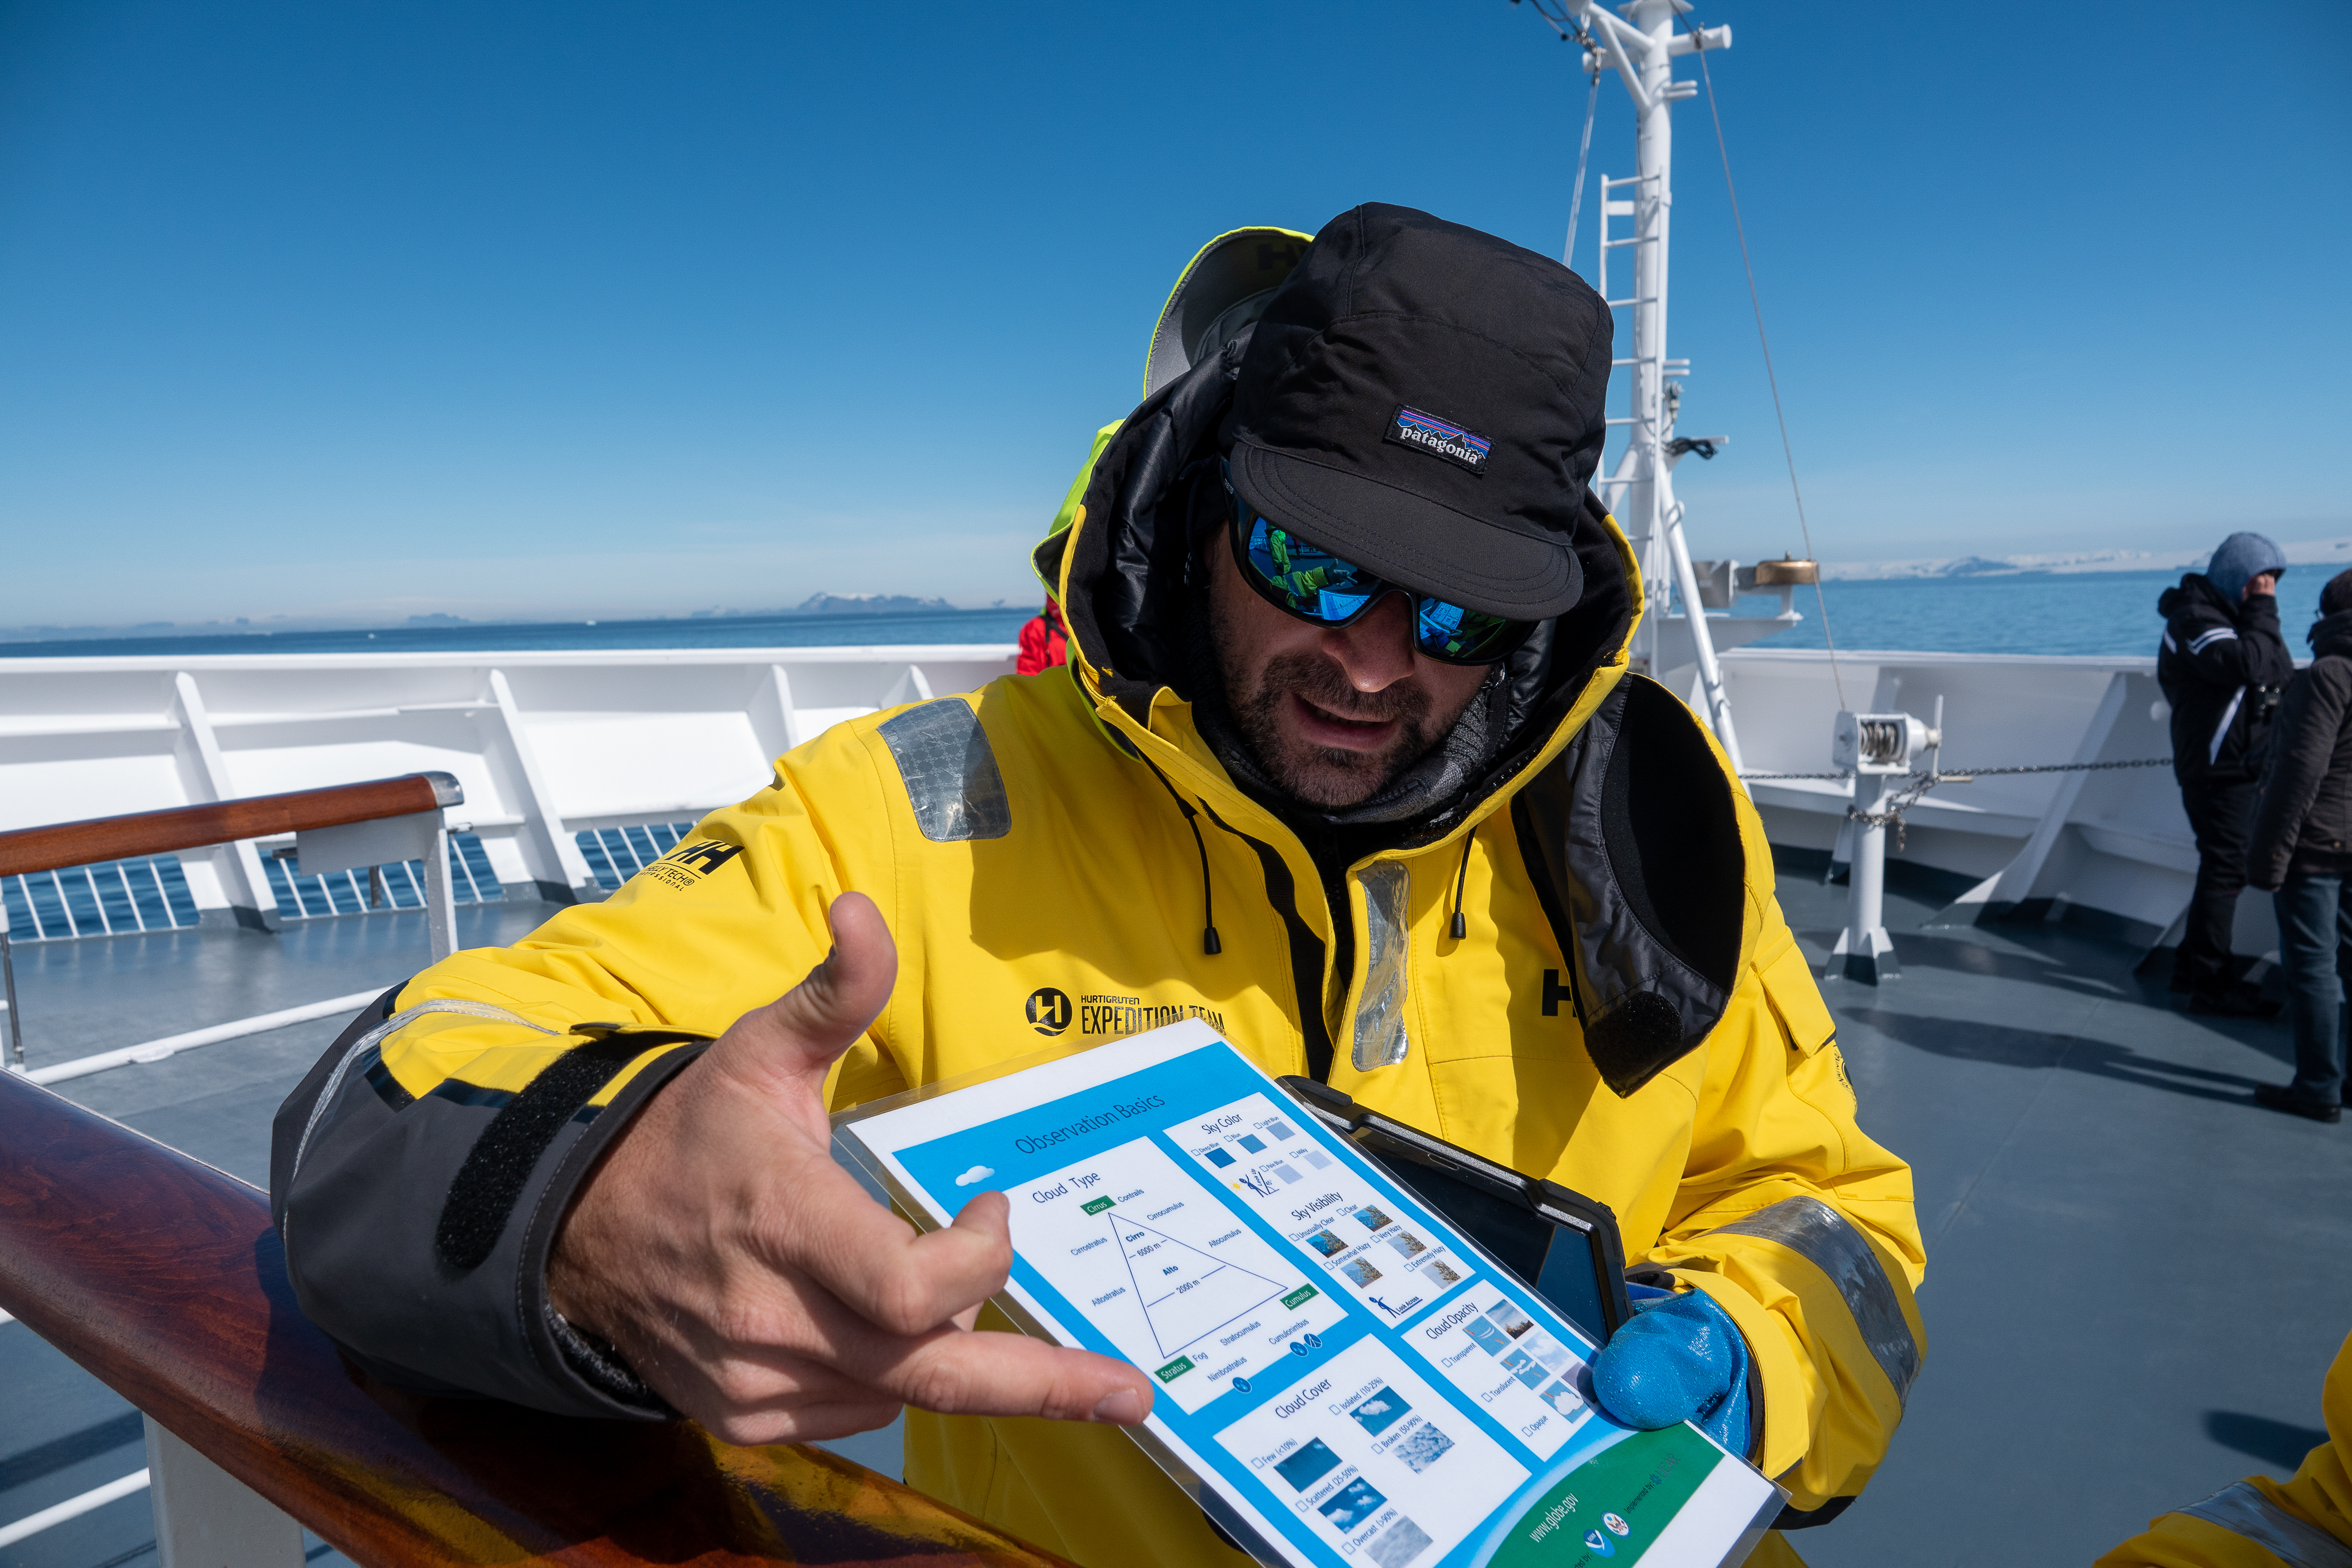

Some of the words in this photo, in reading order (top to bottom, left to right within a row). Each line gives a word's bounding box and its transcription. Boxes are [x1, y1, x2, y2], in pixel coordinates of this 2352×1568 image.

[1081, 995, 1139, 1005] HURTIGRUTEN
[1081, 1005, 1184, 1035] EXPEDITION
[1015, 1115, 1120, 1154] Observation
[1113, 1095, 1165, 1118] Basics
[1202, 1123, 1222, 1134] Sky
[1218, 1113, 1243, 1127] Color
[1260, 1119, 1270, 1127] Light
[1199, 1145, 1210, 1153] Deep
[1032, 1183, 1069, 1203] Cloud
[1069, 1173, 1100, 1188] Type
[1118, 1188, 1144, 1203] Contrails
[1087, 1201, 1107, 1213] Cirrus
[1147, 1201, 1184, 1221] Cirrocumulus
[1292, 1207, 1311, 1221] Sky
[1308, 1191, 1343, 1213] Visibility
[1344, 1204, 1358, 1213] Clear
[1125, 1231, 1145, 1242] Cirro
[1209, 1228, 1241, 1247] Altocumulus
[1297, 1222, 1323, 1239] Unusually
[1320, 1216, 1335, 1228] Clear
[1379, 1230, 1390, 1239] Very
[1389, 1224, 1403, 1234] Hazy
[1071, 1236, 1107, 1256] Cirrostratus
[1137, 1245, 1154, 1256] 6000
[1332, 1249, 1357, 1266] Somewhat
[1356, 1242, 1371, 1253] Hazy
[1412, 1252, 1435, 1268] Extremely
[1432, 1245, 1446, 1256] Hazy
[1162, 1265, 1179, 1275] Alto
[1092, 1286, 1126, 1306] Altostratus
[1176, 1283, 1193, 1294] 2000
[1285, 1289, 1311, 1307] Cumulus
[1405, 1295, 1419, 1306] Across
[1426, 1318, 1452, 1339] Cloud
[1447, 1302, 1479, 1324] Opacity
[1220, 1320, 1261, 1346] Stratocumulus
[1268, 1318, 1309, 1345] Cumulonimbus
[1192, 1351, 1209, 1362] Fog
[1449, 1342, 1477, 1363] Transparent
[1161, 1362, 1187, 1379] Stratus
[1207, 1357, 1247, 1382] Nimbostratus
[1340, 1392, 1362, 1410] Isolated
[1360, 1377, 1384, 1396] (10-25%)
[1490, 1375, 1516, 1398] Translucent
[1275, 1396, 1306, 1418] Cloud
[1302, 1378, 1332, 1400] Cover
[1381, 1431, 1401, 1448] Broken
[1399, 1415, 1423, 1434] (50-90%)
[1530, 1415, 1548, 1431] Opaque
[1262, 1452, 1277, 1464] Few
[1276, 1438, 1298, 1456] (<10%)
[1655, 1453, 1680, 1479] UCAR
[1306, 1482, 1335, 1506] Scattered
[1332, 1464, 1359, 1486] (25-50%)
[1623, 1487, 1648, 1514] Implemented
[1645, 1482, 1654, 1490] by:
[1353, 1524, 1379, 1547] Overcast
[1376, 1508, 1399, 1527] (>90%)
[1529, 1492, 1579, 1543] www.globe.gov
